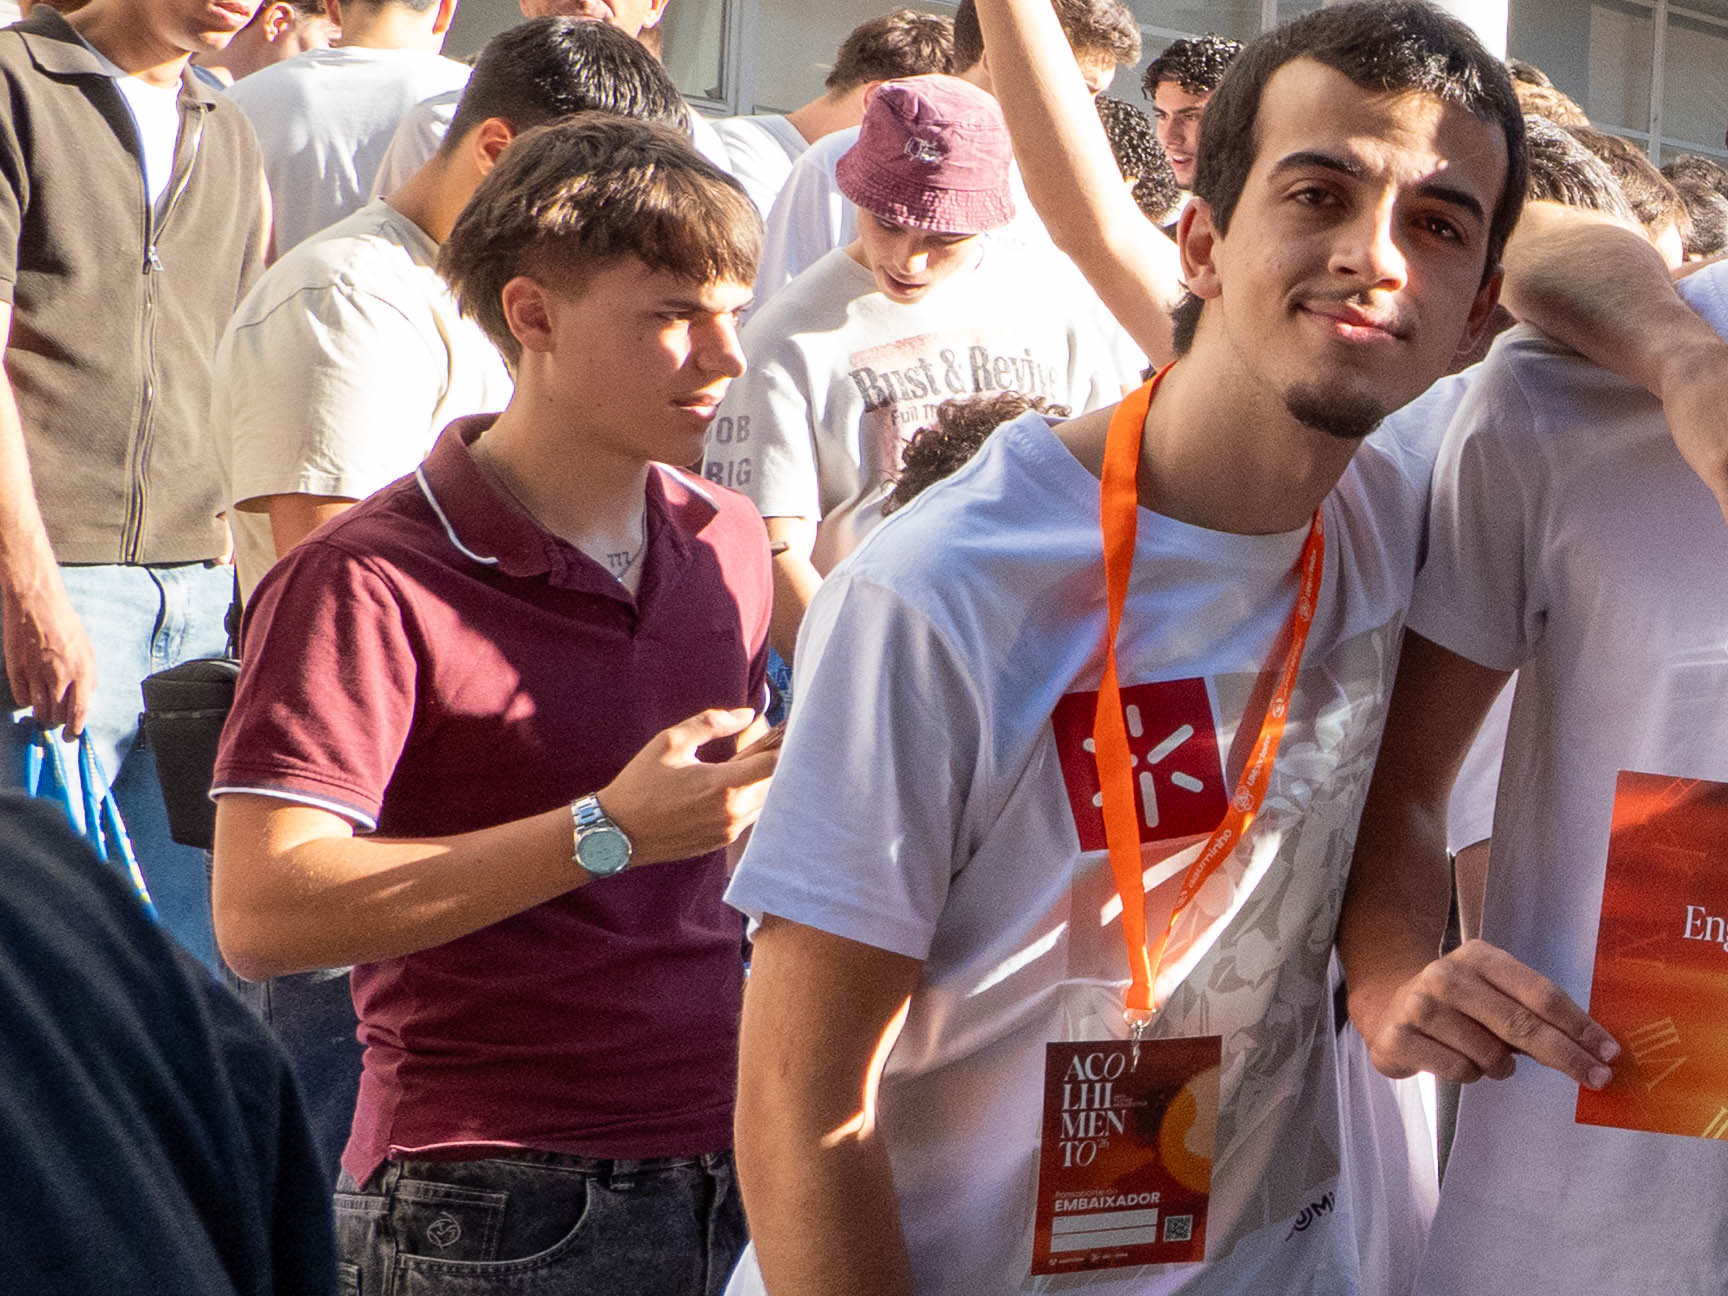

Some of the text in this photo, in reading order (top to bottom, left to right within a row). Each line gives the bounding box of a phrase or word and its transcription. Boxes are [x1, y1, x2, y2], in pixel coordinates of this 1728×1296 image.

[939, 348, 966, 393] &
[706, 457, 750, 487] BIG
[1063, 1052, 1126, 1081] ACO
[1062, 1082, 1113, 1110] LHI
[1060, 1109, 1127, 1138] MEN
[1059, 1140, 1097, 1168] TO
[1054, 1191, 1161, 1212] EMBAIXADOR
